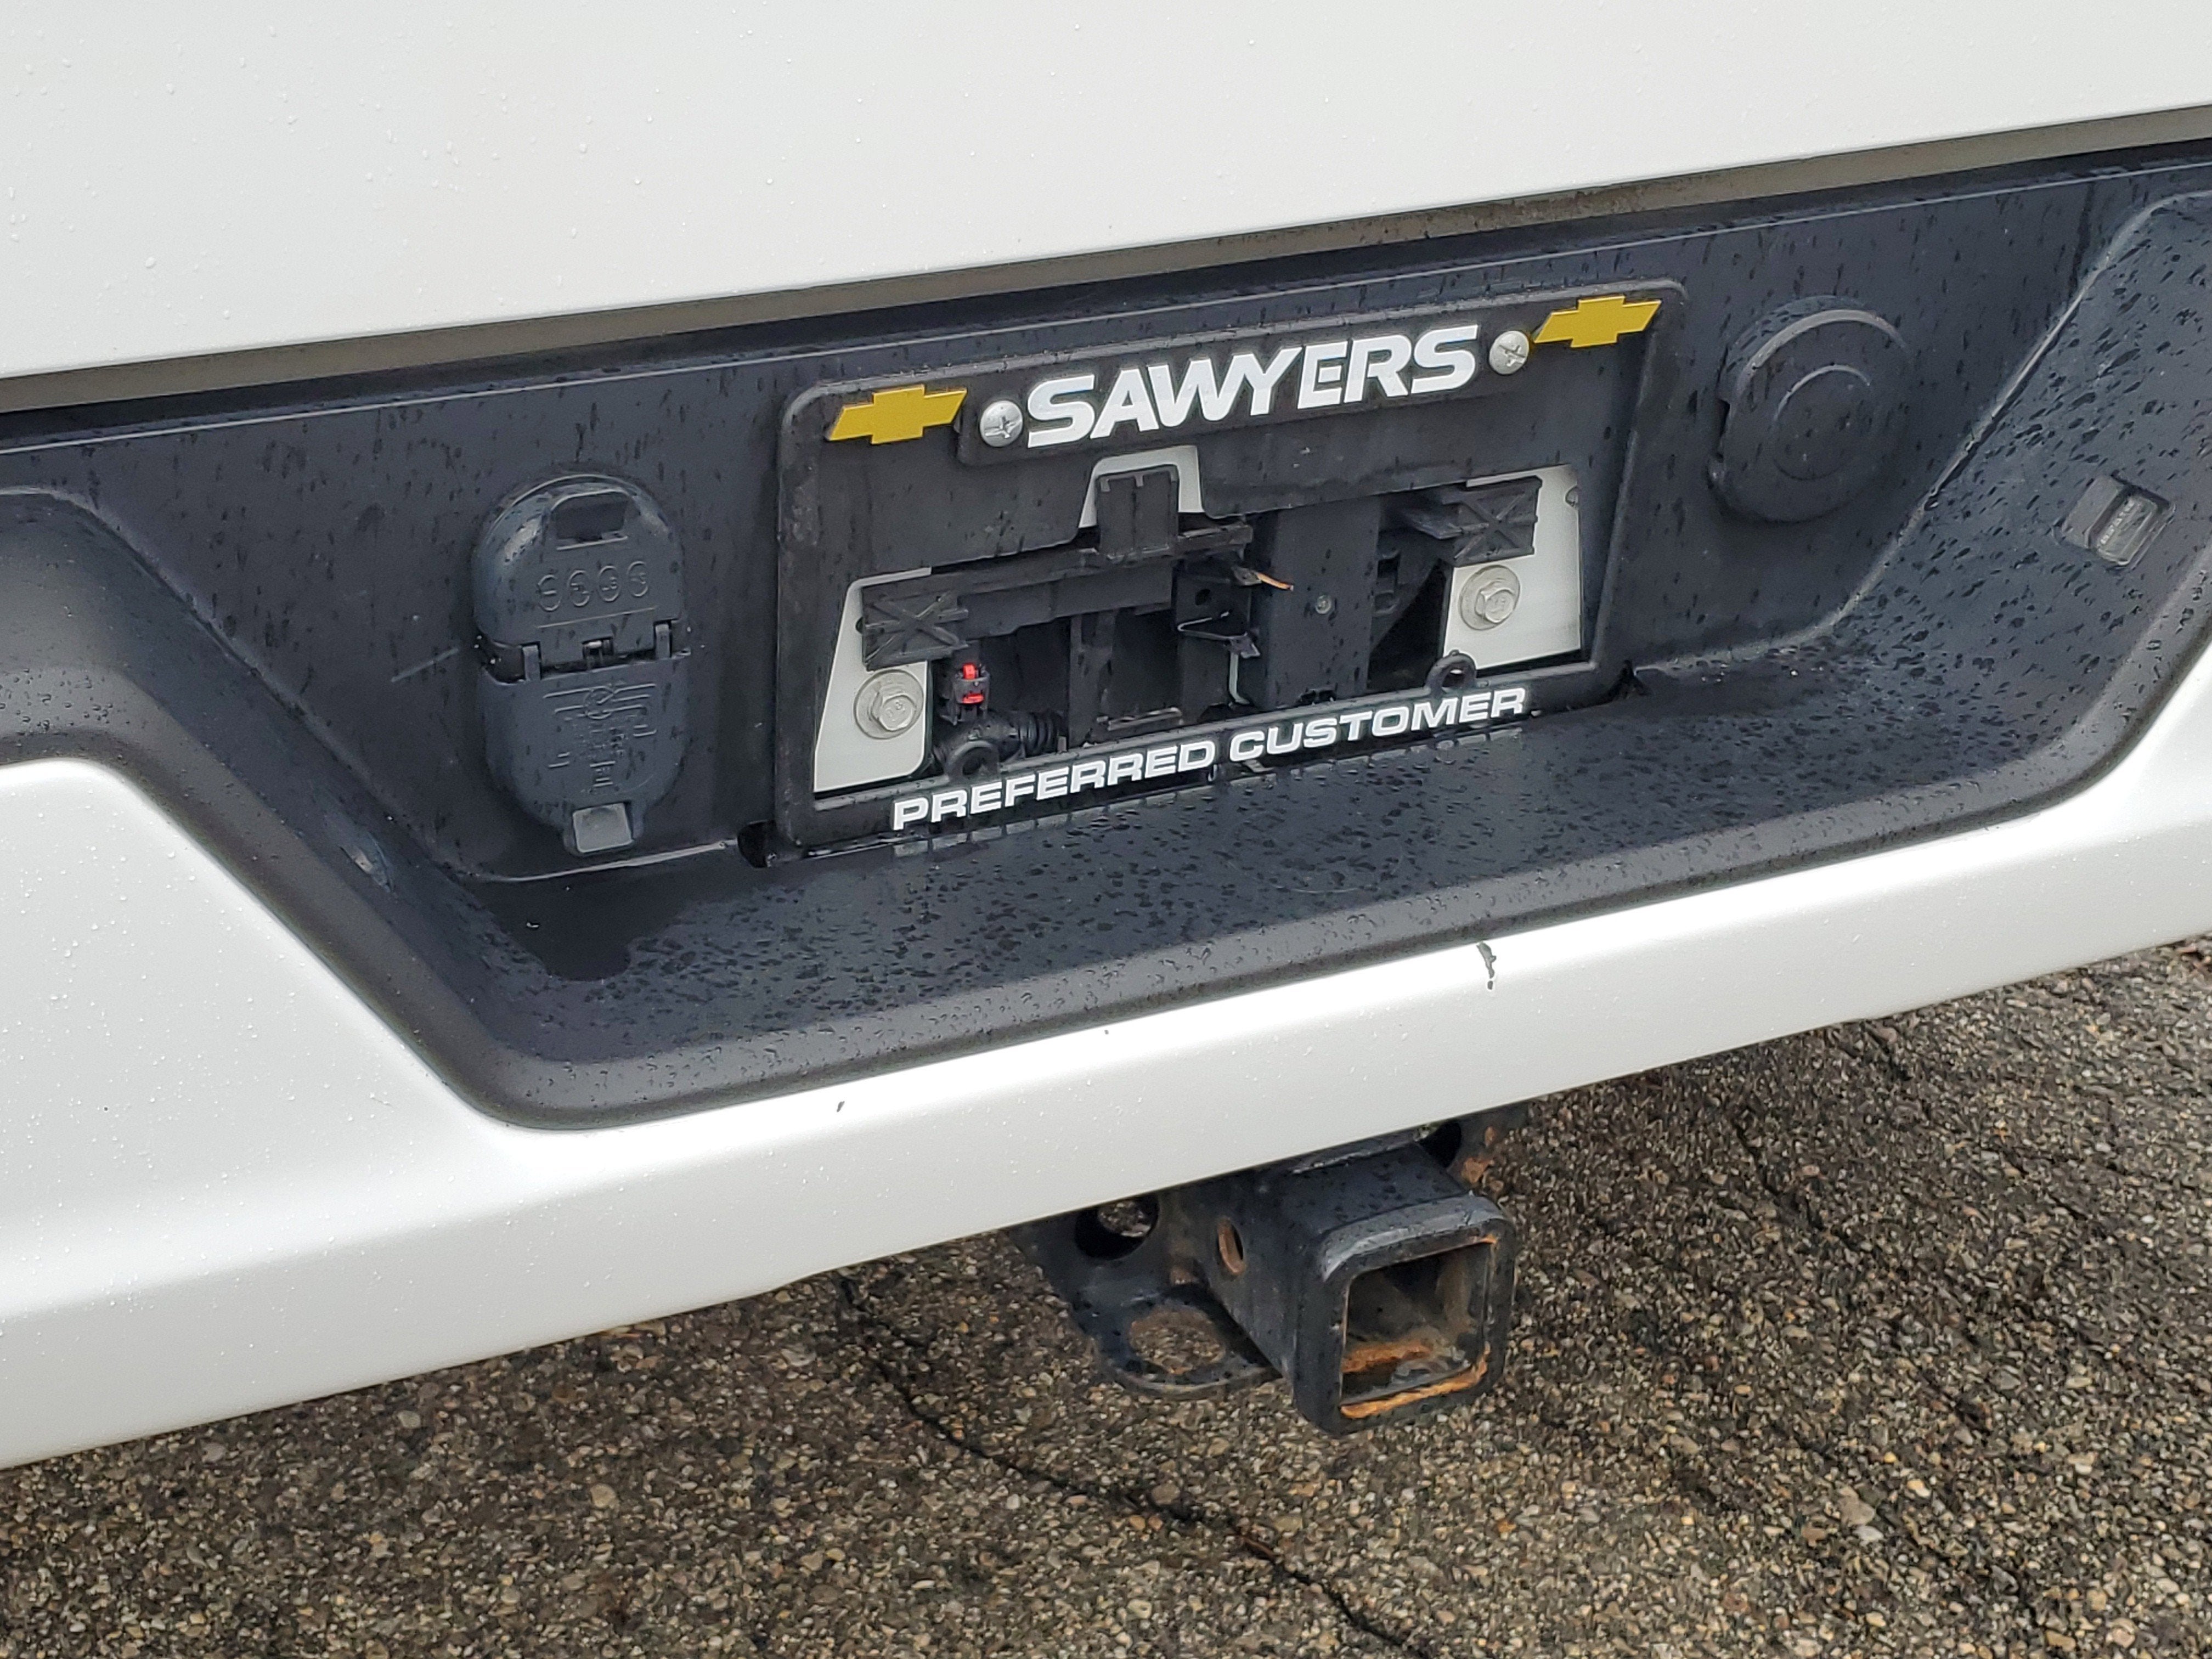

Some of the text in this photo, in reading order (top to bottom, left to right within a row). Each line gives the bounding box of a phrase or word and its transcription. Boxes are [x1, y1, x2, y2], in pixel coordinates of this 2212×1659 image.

[1027, 324, 1479, 448] SAWYERS
[893, 687, 1527, 831] PREFERRED CUSTOMER
